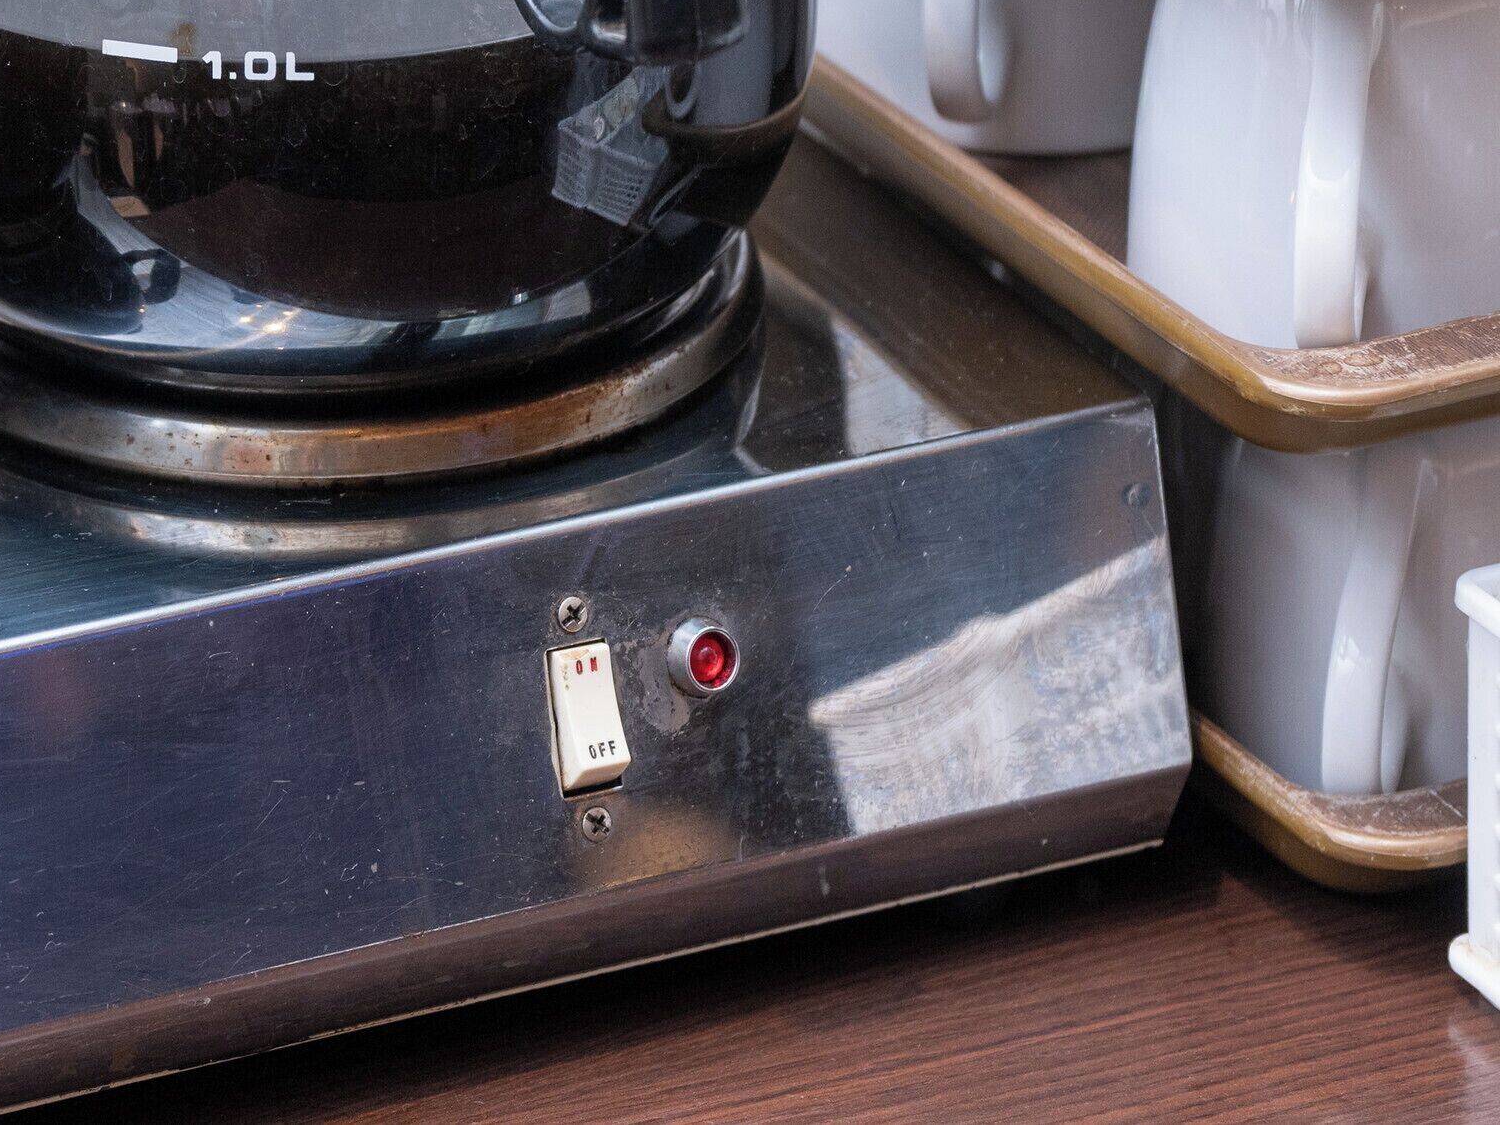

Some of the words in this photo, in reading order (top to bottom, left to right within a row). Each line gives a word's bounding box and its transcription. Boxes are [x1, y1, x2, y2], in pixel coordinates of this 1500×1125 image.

[201, 50, 315, 82] 1.0L
[576, 656, 598, 676] ON
[588, 740, 617, 760] OFF
